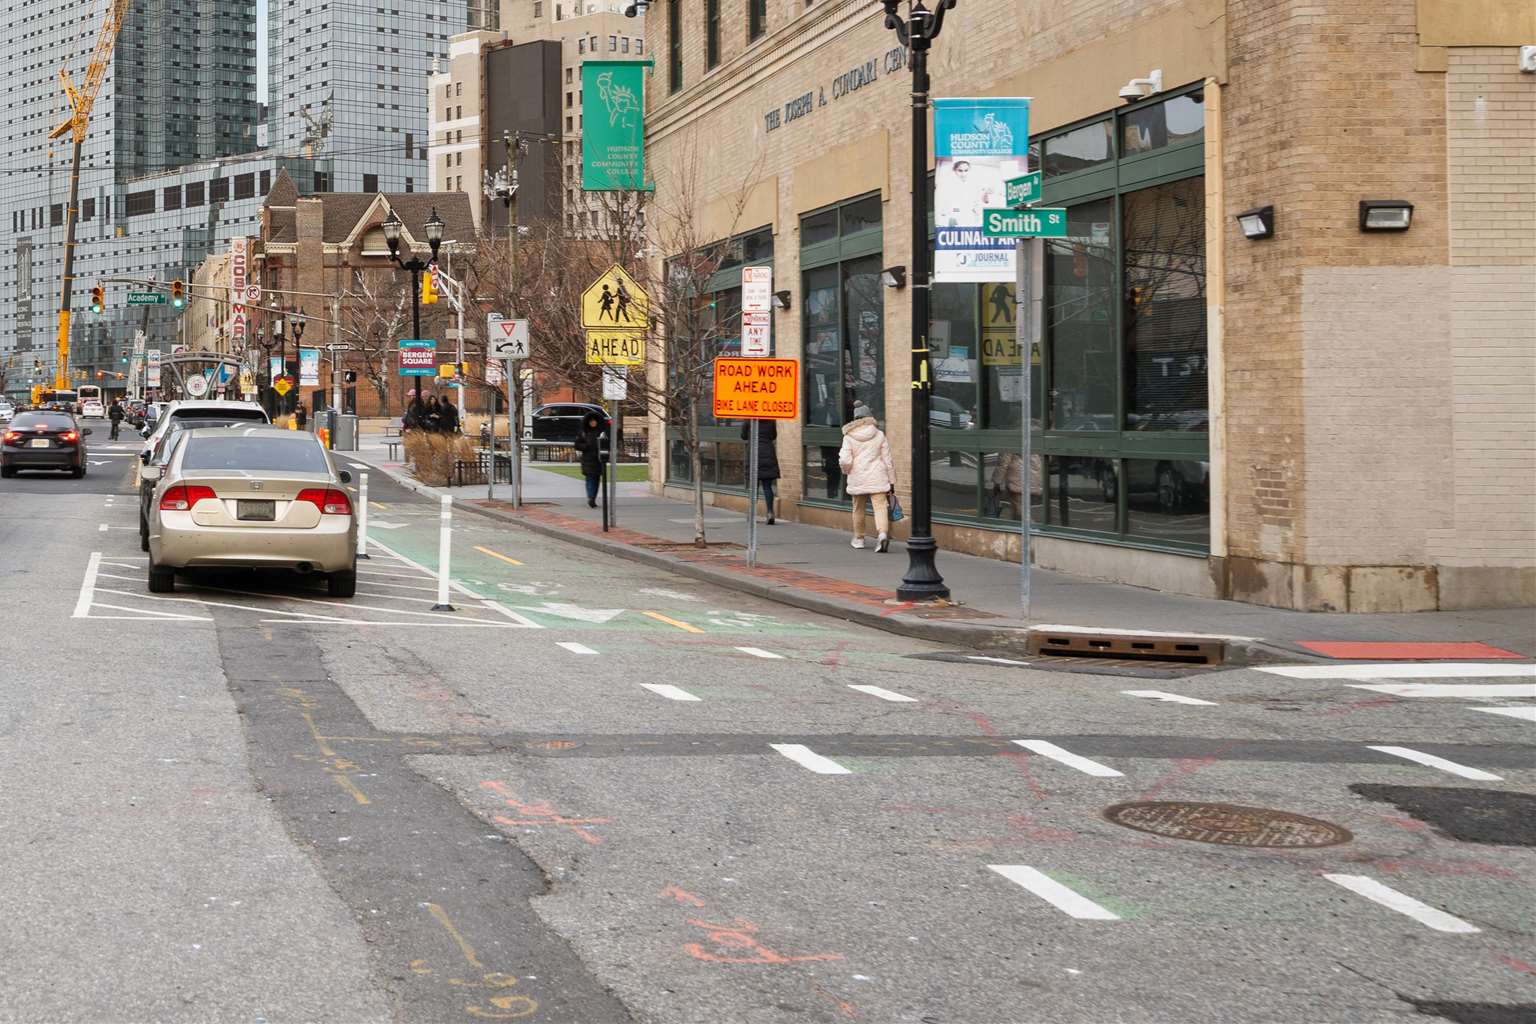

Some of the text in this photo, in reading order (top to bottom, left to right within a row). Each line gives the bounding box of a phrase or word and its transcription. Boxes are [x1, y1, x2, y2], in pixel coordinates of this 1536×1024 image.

[765, 108, 781, 133] THE
[784, 91, 813, 124] JOSEPH
[832, 58, 878, 100] CUNDARI
[950, 133, 990, 141] HUDSON
[950, 141, 990, 150] COUNTY
[1007, 182, 1033, 201] Bergen
[989, 213, 1060, 233] Smith St
[975, 252, 1009, 262] JOURNAL
[128, 294, 159, 303] Academy
[749, 327, 764, 335] ANY
[591, 338, 640, 357] AHEAD
[719, 365, 793, 378] ROAD WORK
[733, 381, 777, 393] AHEAD
[716, 400, 793, 413] BIKE LANE CLOSED
